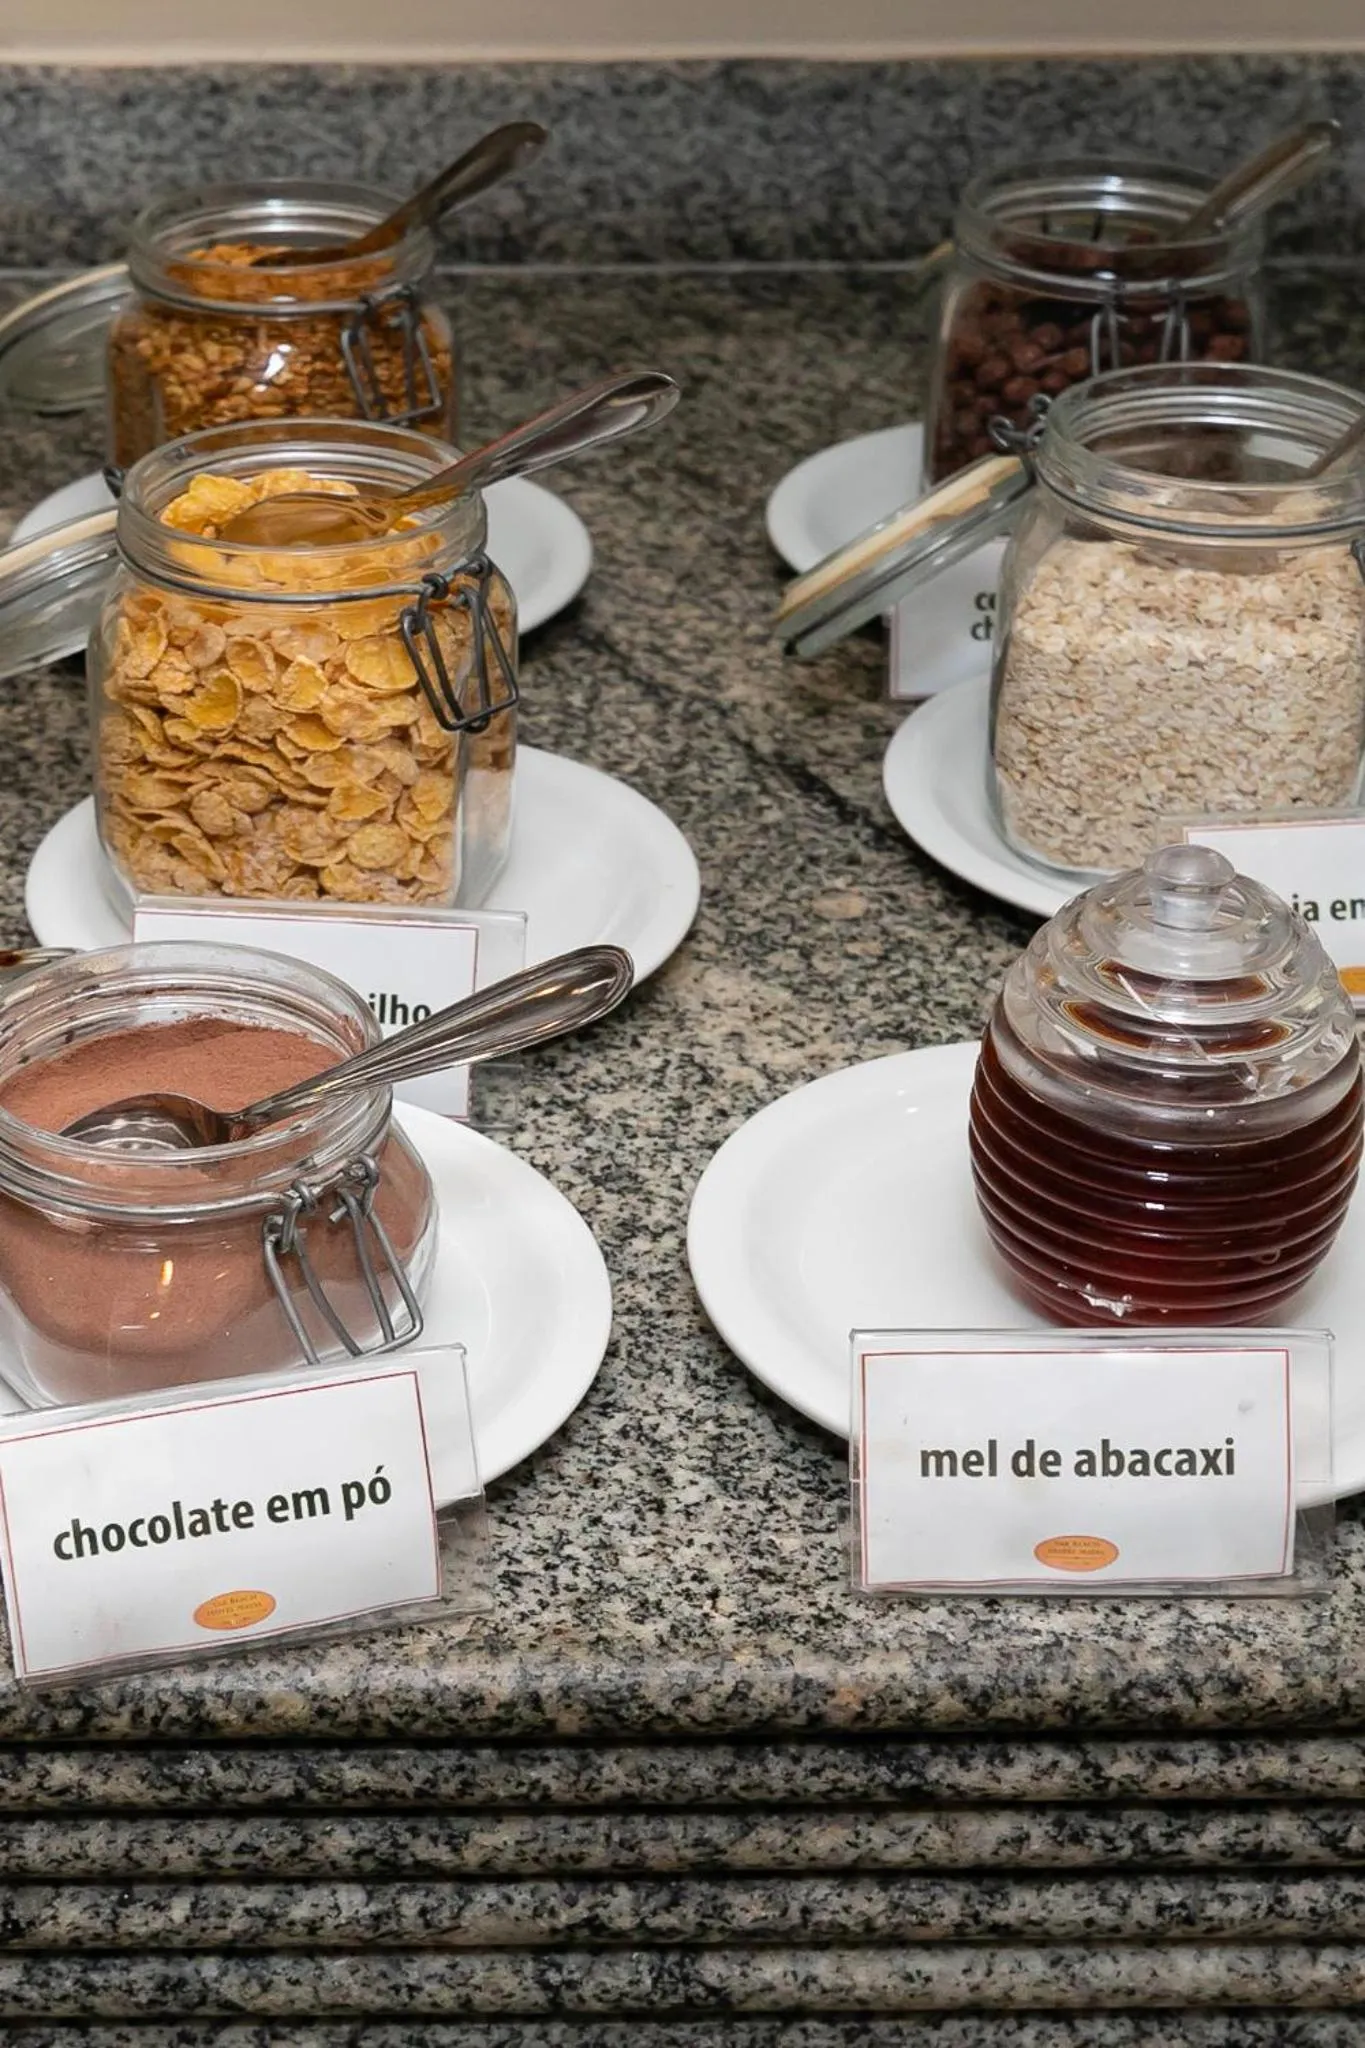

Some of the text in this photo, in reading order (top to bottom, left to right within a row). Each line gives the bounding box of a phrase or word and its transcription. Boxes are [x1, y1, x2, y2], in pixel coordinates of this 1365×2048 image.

[920, 1437, 1236, 1478] mel de abacaxi
[53, 1465, 393, 1561] chocolate em pó
